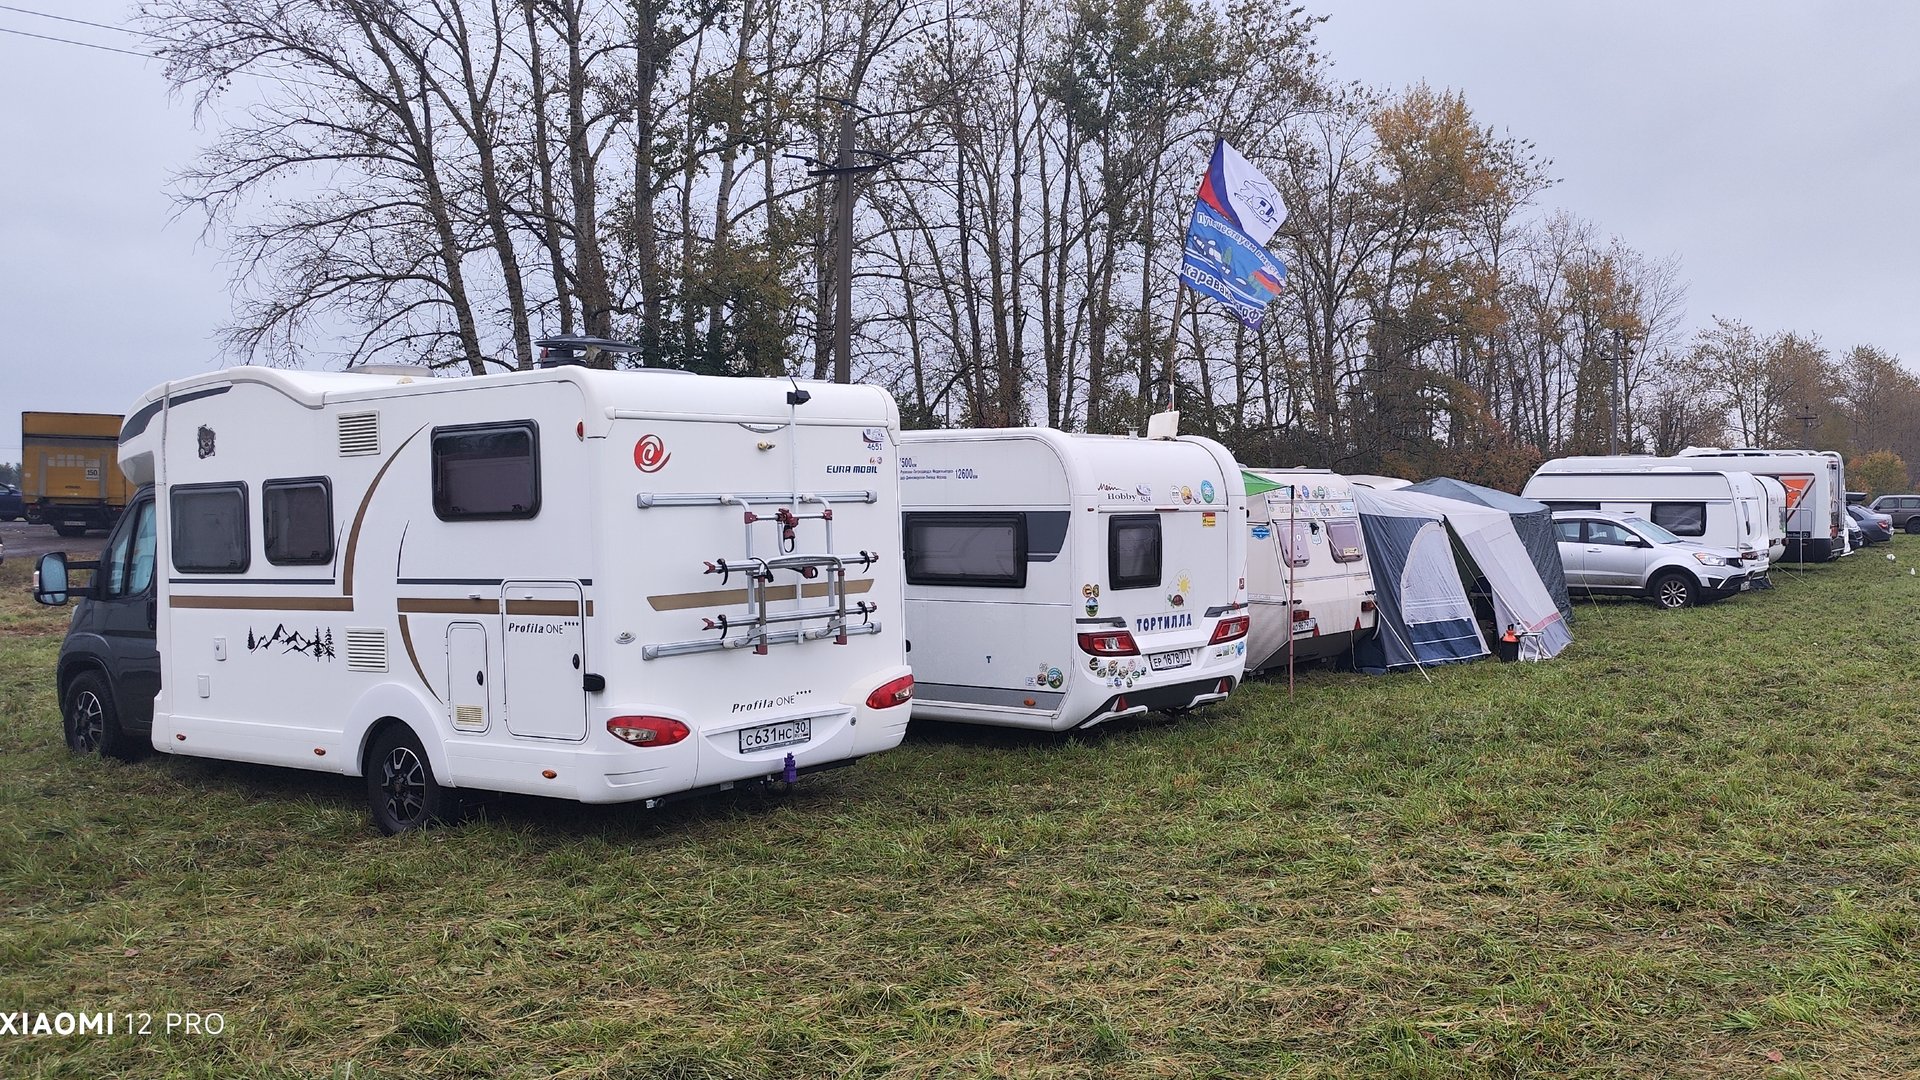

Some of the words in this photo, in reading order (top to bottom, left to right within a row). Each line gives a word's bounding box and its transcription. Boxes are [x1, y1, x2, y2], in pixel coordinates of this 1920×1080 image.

[826, 465, 851, 473] EURA
[853, 465, 877, 473] MOBIL
[1107, 493, 1137, 502] Hobby
[508, 622, 544, 634] Profila
[546, 624, 563, 635] ONE
[1136, 613, 1192, 632] ТОРТИЛЛА
[731, 699, 774, 713] Profila
[776, 695, 795, 706] ONE
